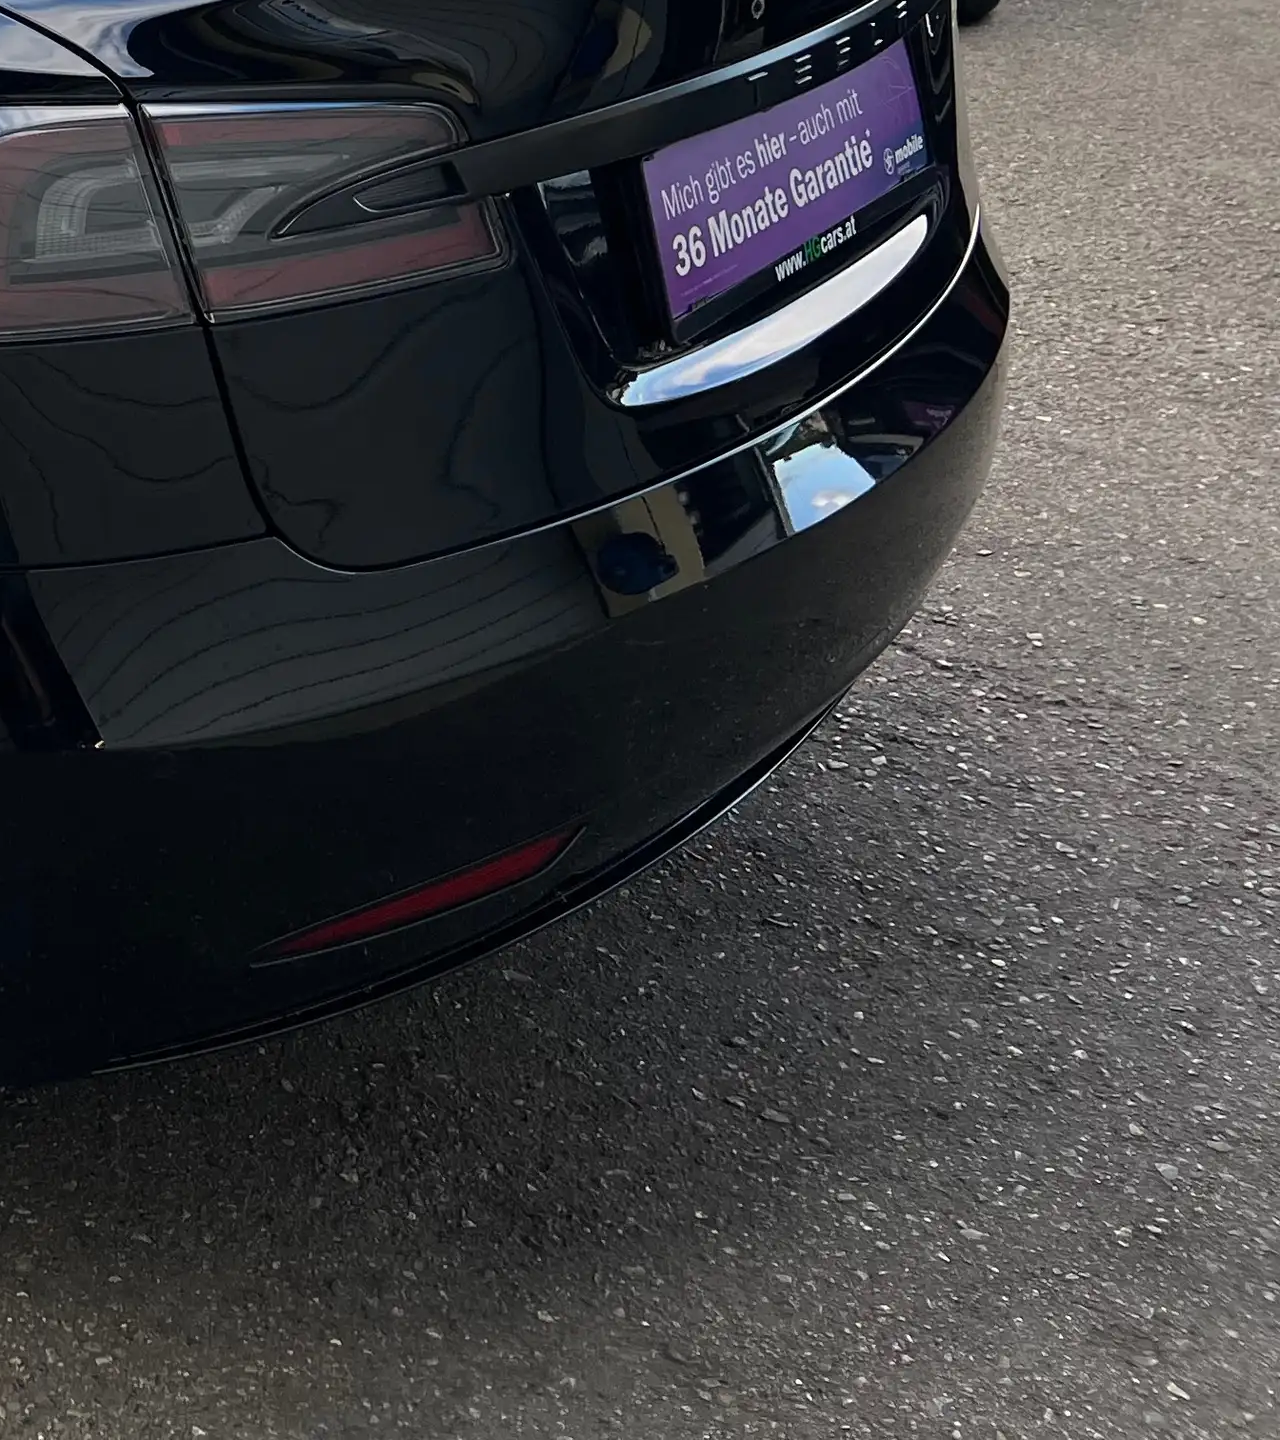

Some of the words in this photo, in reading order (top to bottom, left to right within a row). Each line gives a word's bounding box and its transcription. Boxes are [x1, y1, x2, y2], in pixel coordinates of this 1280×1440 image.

[661, 174, 704, 221] Mich
[705, 157, 737, 205] gibt
[736, 150, 756, 179] es
[754, 131, 787, 169] hier
[798, 102, 835, 146] auch
[836, 88, 864, 125] mit
[895, 133, 924, 165] mobile
[672, 224, 706, 277] 36
[707, 186, 789, 258] Monate
[775, 215, 858, 282] www.HGcars.at
